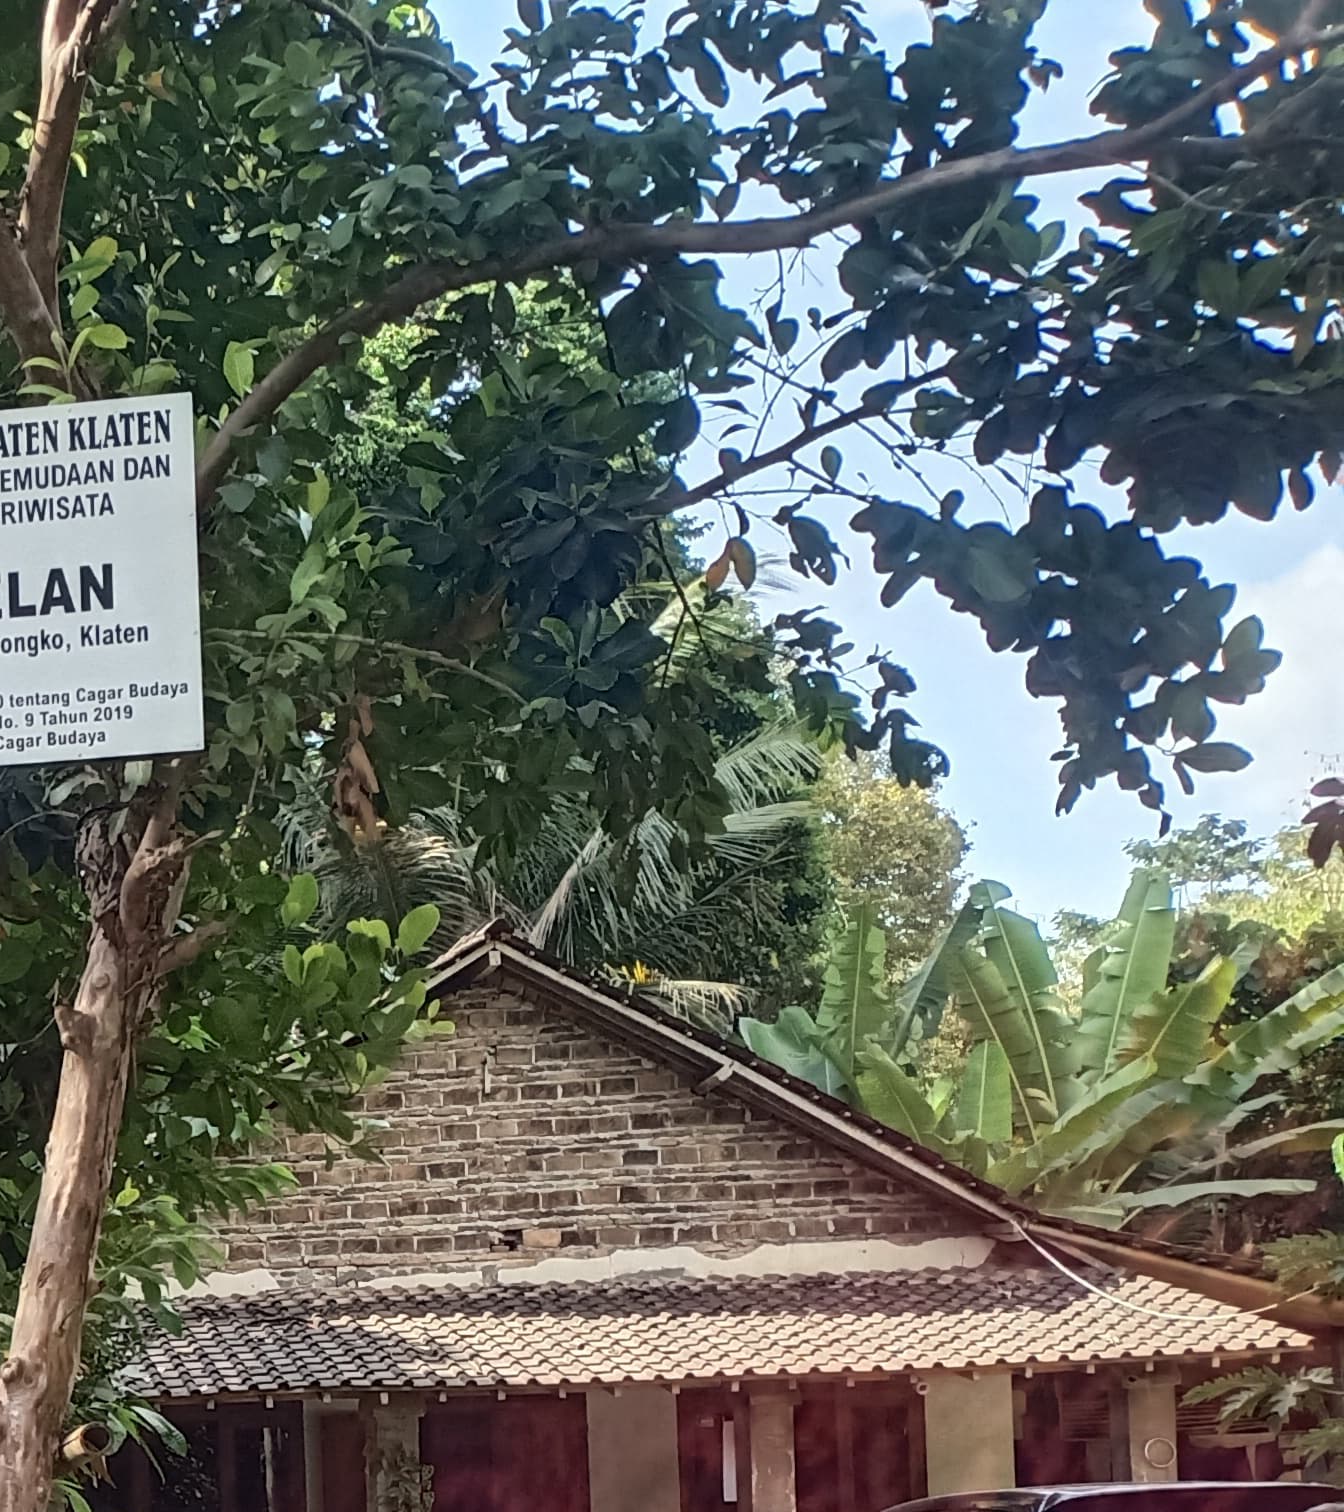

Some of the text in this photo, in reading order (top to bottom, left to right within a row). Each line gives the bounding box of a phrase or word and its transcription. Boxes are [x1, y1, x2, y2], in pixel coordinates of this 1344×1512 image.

[67, 408, 171, 452] KLATEN
[123, 453, 171, 482] DAN
[80, 623, 149, 648] Klaten
[9, 692, 70, 708] tentang
[75, 687, 124, 705] Cagar
[128, 681, 189, 699] Budaya
[24, 712, 35, 728] 9
[39, 710, 88, 726] Tahun
[93, 704, 133, 722] 2019
[47, 729, 106, 746] Budaya
